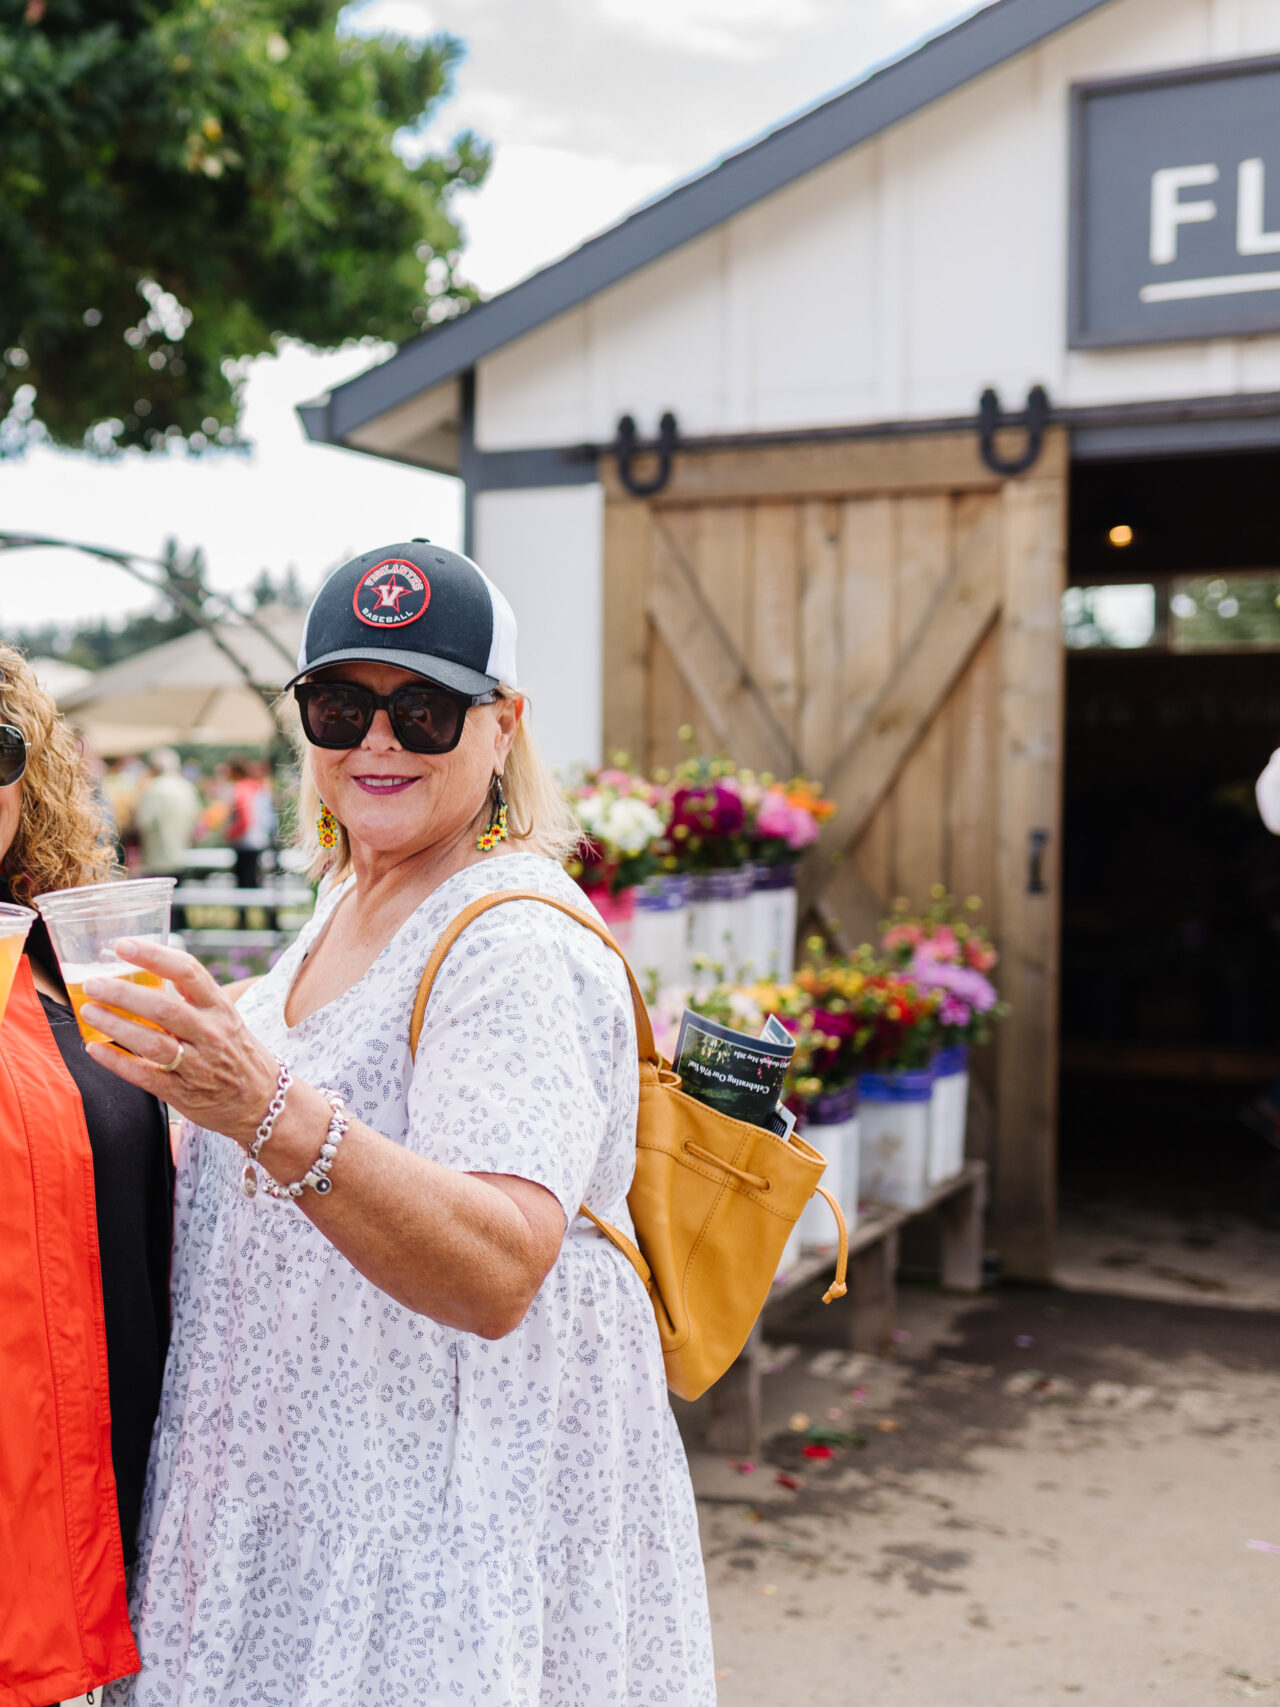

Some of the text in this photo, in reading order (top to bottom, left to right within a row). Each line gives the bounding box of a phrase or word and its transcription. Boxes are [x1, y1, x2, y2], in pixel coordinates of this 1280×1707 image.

[1149, 157, 1280, 265] FL
[379, 585, 404, 606] V
[362, 607, 413, 623] BASEBALL
[712, 1071, 726, 1083] Our
[727, 1074, 770, 1095] Celebrating
